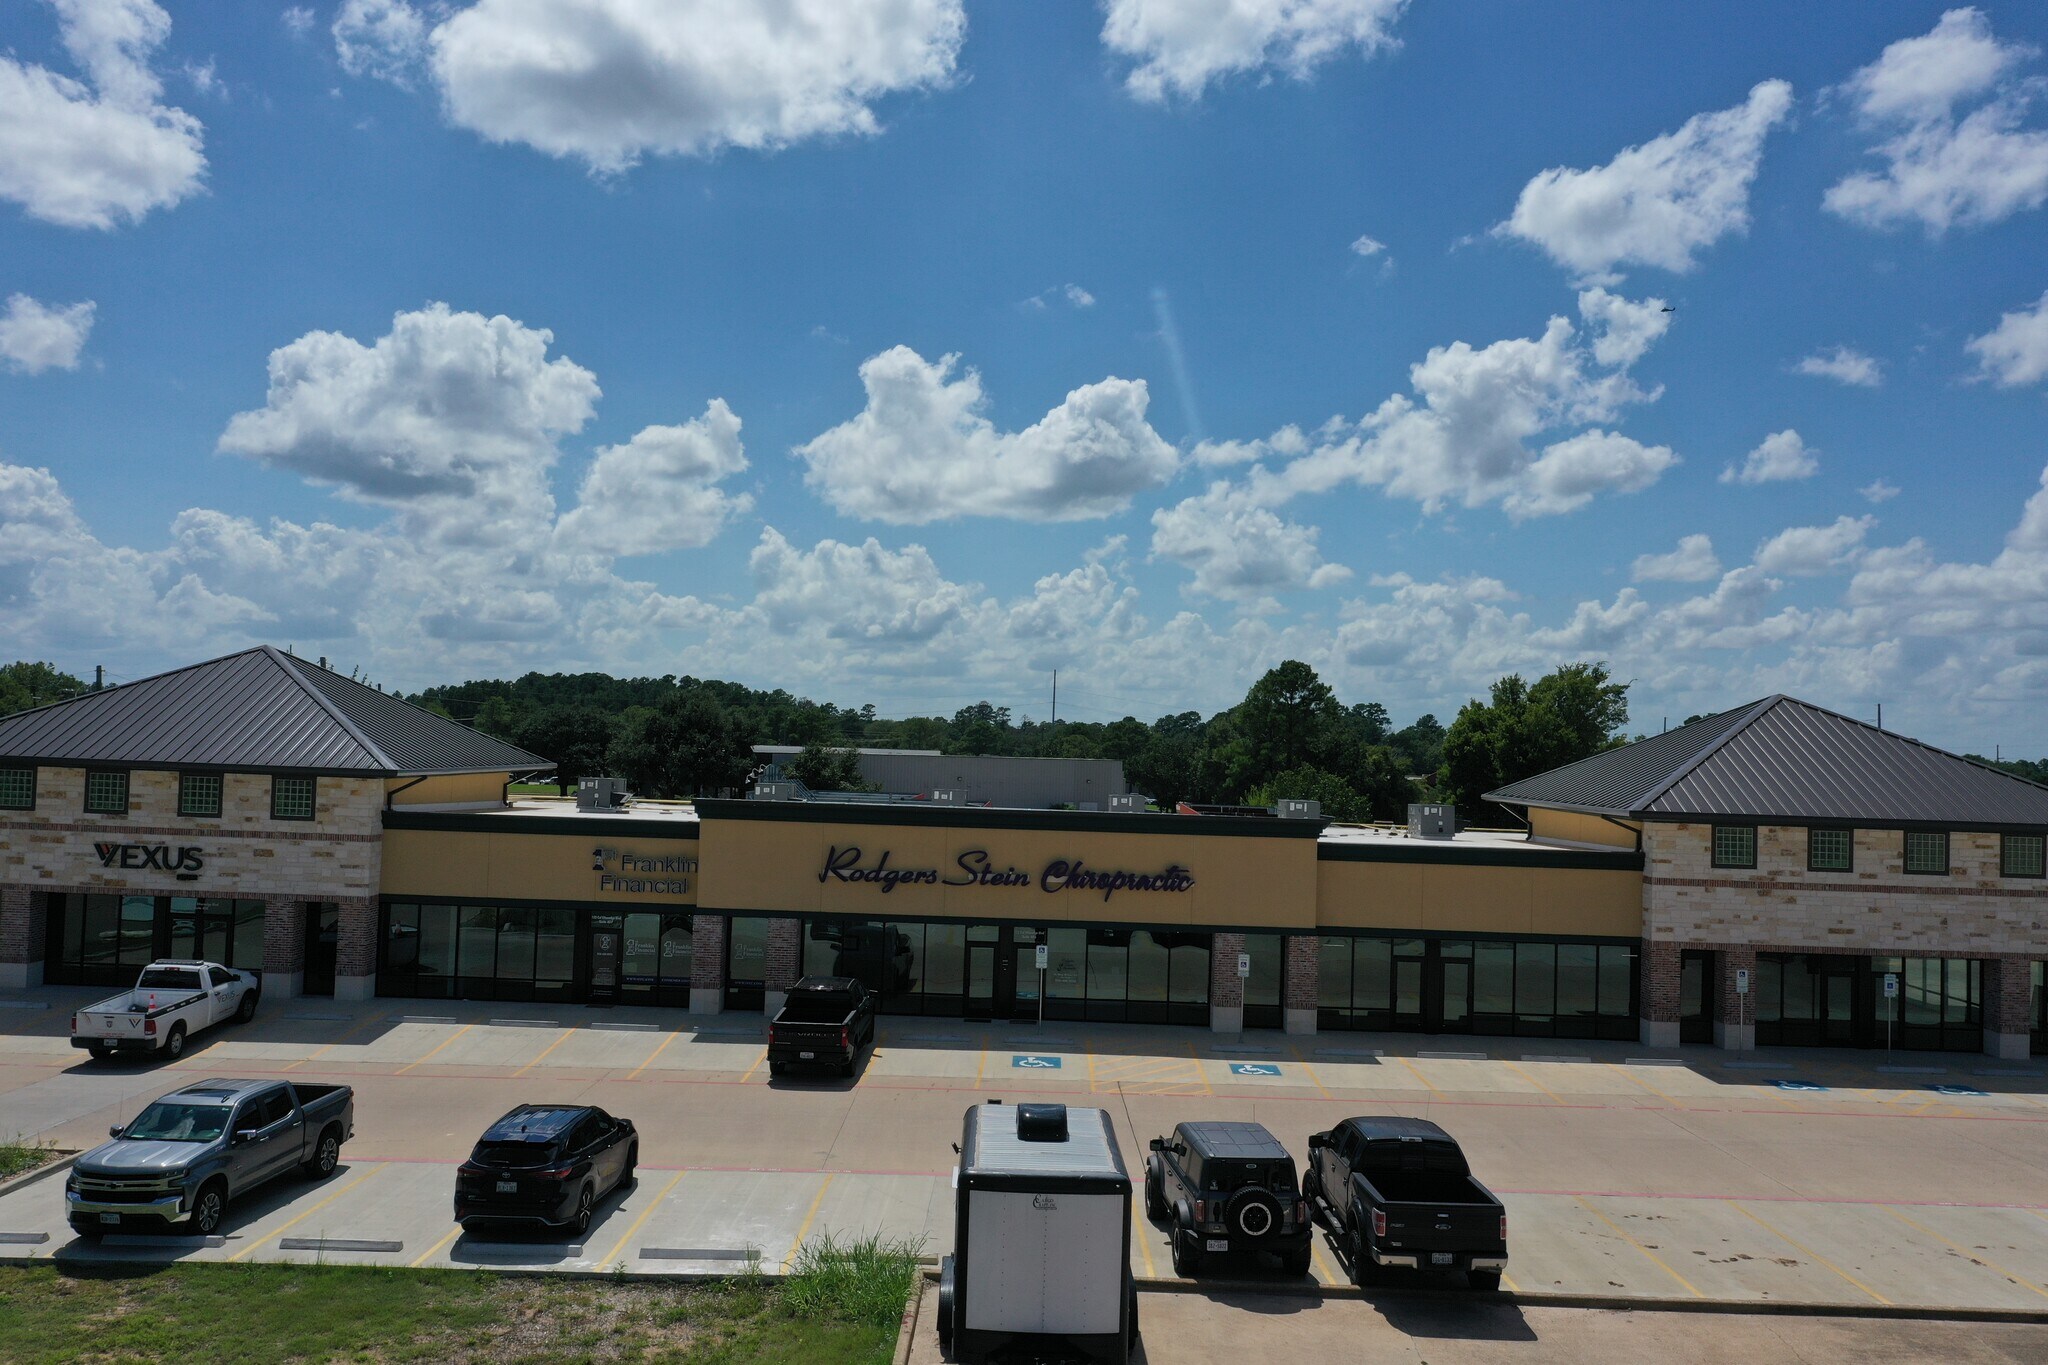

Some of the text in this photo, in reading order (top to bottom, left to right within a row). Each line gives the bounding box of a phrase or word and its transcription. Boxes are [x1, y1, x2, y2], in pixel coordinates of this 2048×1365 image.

[93, 843, 204, 871] VEXUS
[621, 854, 699, 874] Franklin
[600, 874, 689, 895] Financial
[818, 845, 1195, 903] Rodgers Stein Chiropractic
